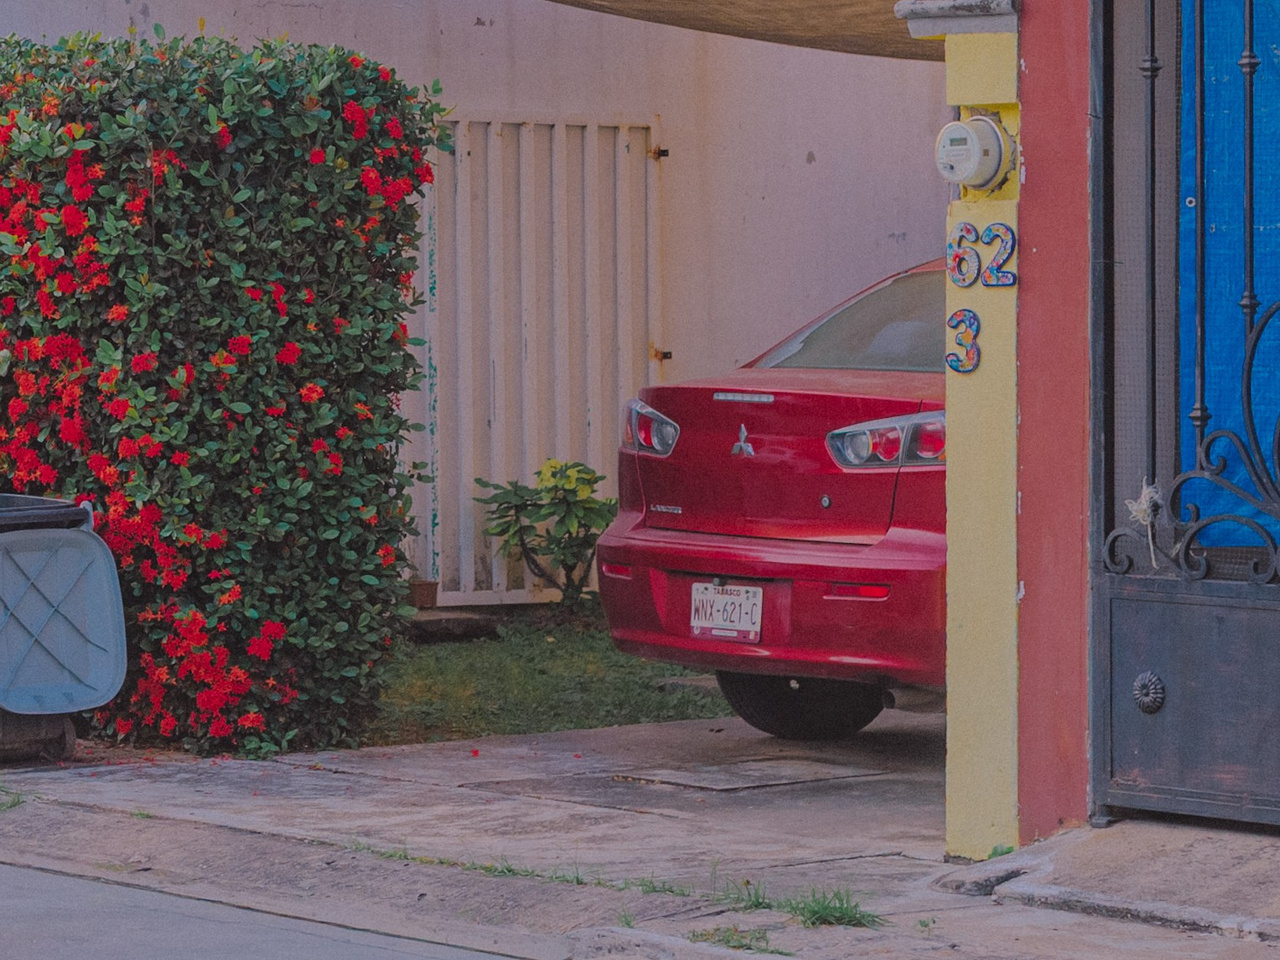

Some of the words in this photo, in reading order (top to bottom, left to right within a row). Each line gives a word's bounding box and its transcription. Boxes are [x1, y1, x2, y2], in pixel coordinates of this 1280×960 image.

[947, 222, 1017, 287] 62
[946, 308, 981, 373] 3
[693, 599, 758, 625] WNX-621-C
[713, 587, 741, 597] TABASCO
